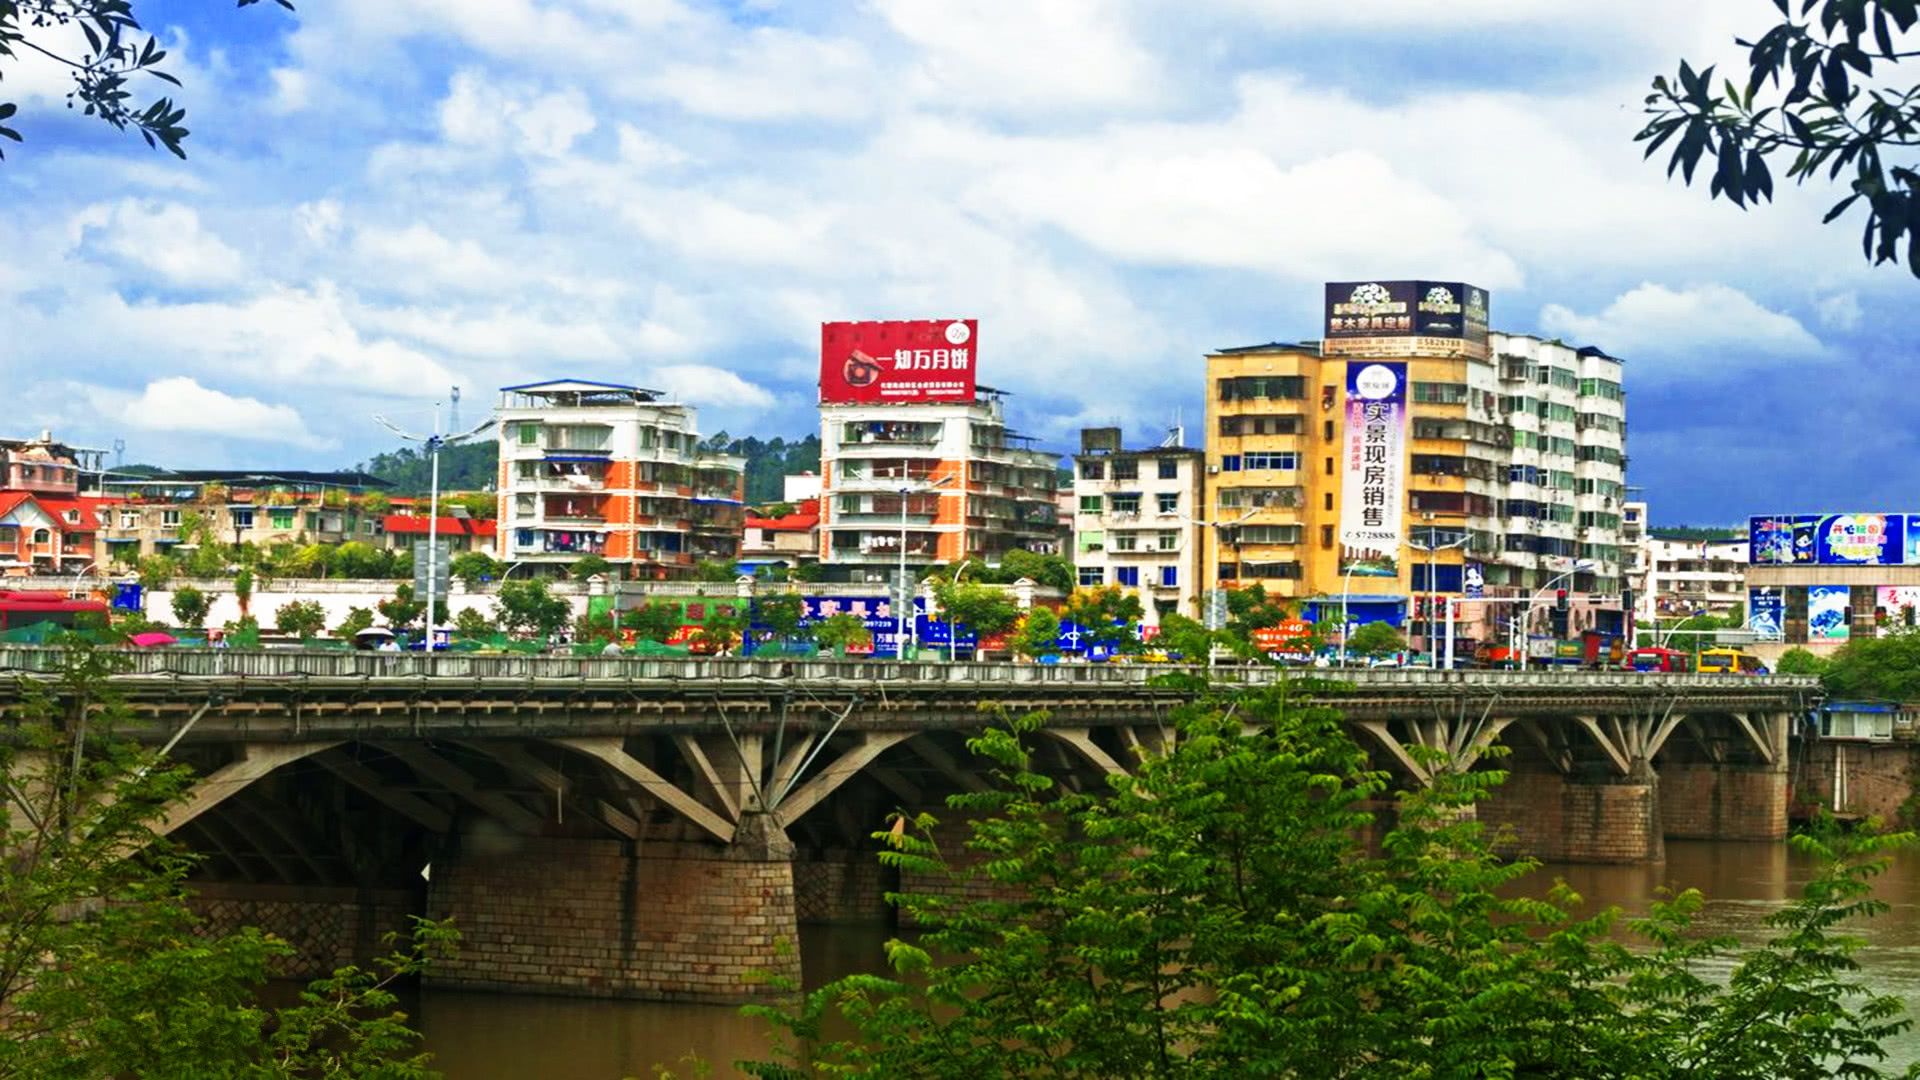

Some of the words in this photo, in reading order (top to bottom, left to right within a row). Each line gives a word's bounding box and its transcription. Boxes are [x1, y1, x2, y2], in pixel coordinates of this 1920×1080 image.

[1362, 402, 1388, 527] 实景现房销售
